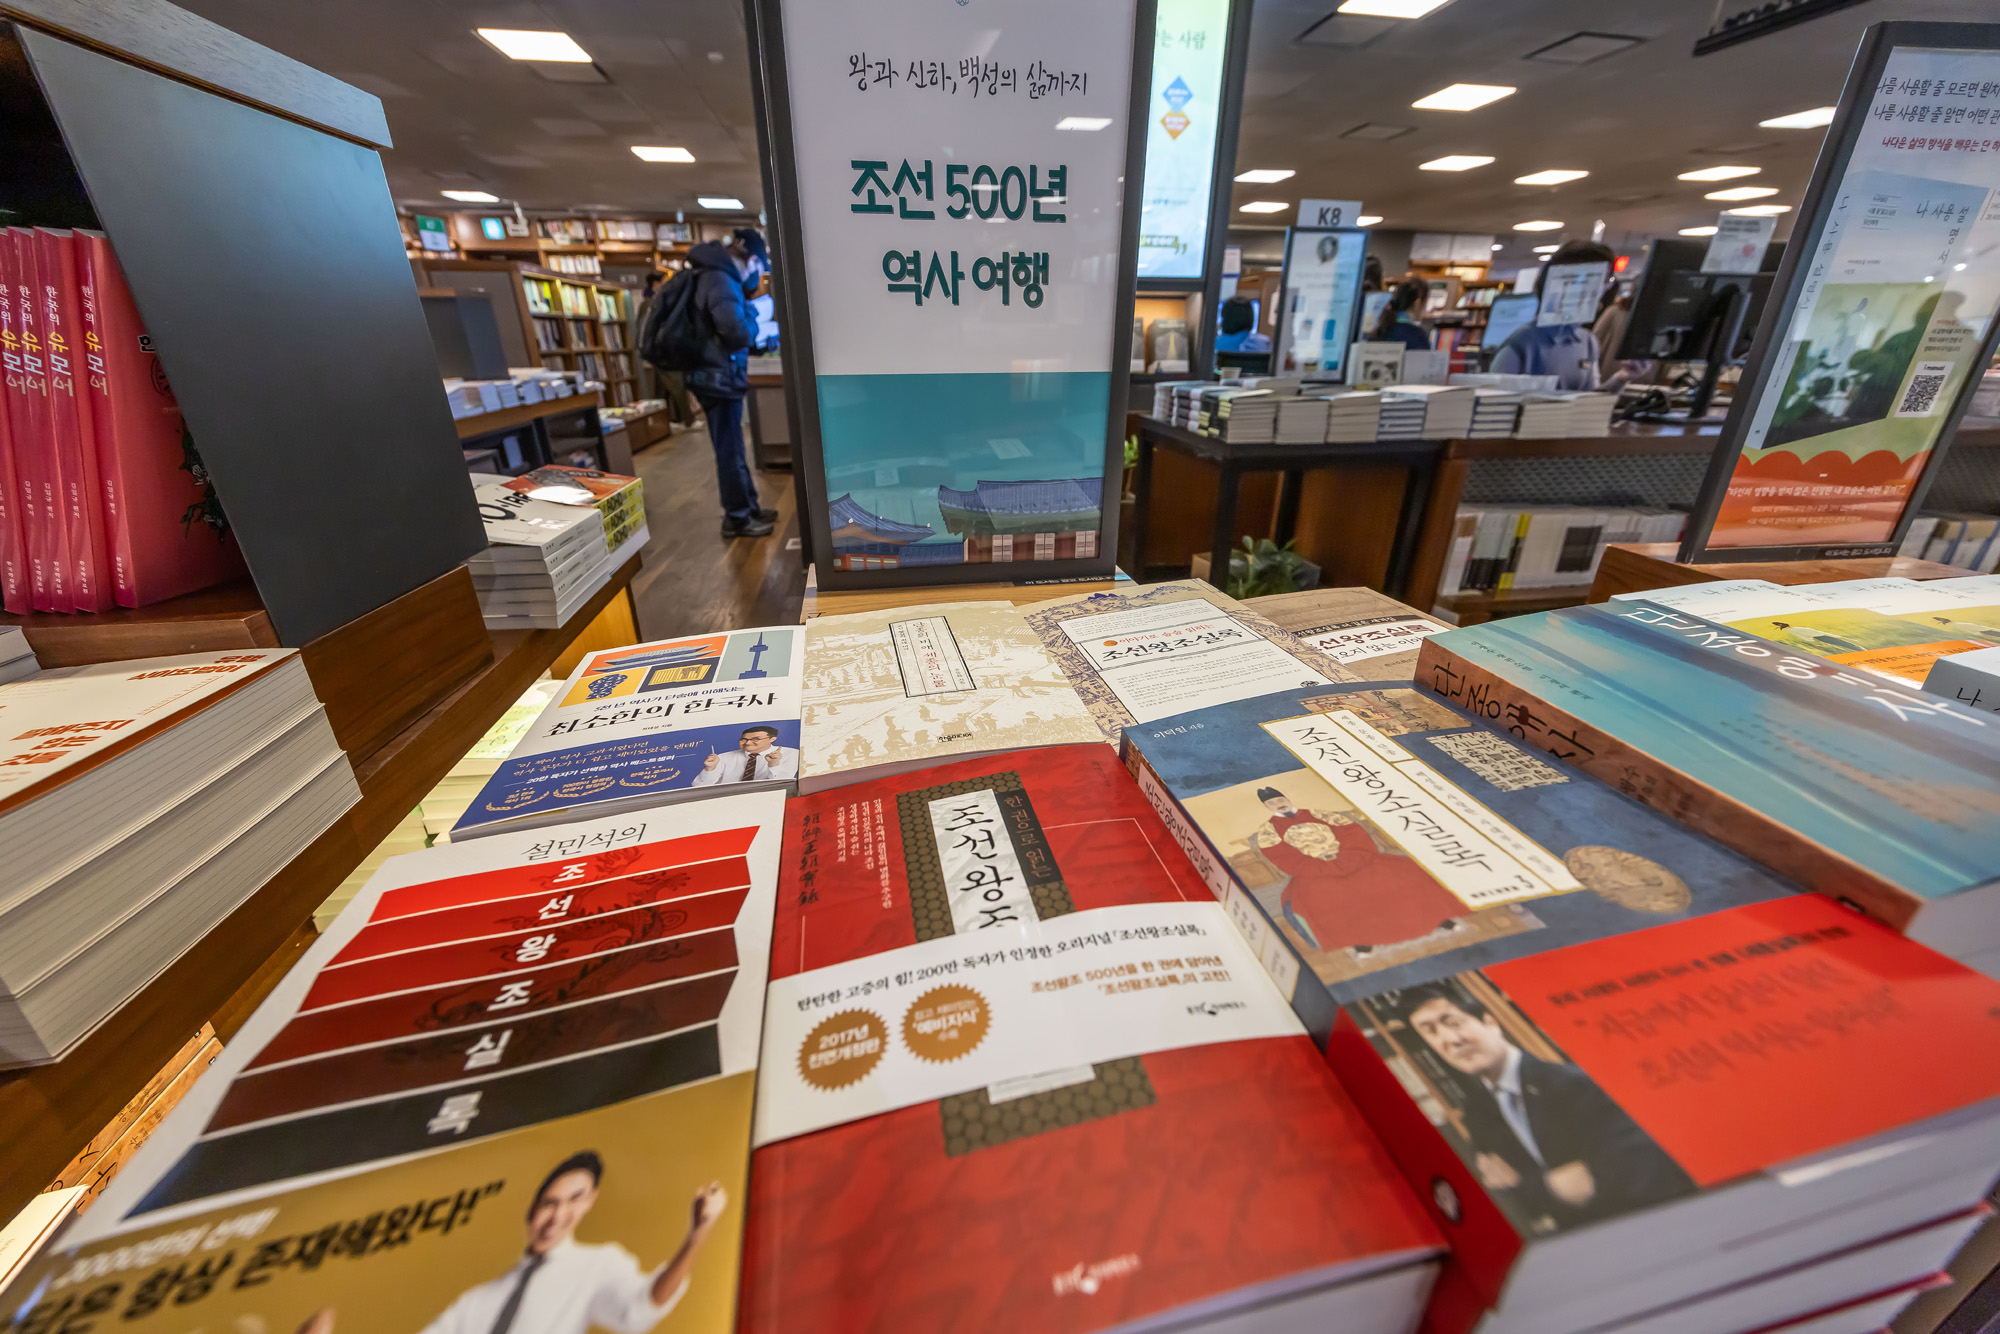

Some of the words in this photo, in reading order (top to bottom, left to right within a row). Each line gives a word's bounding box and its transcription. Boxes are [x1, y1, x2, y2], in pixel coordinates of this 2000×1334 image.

[848, 52, 899, 91] 왕과
[1026, 60, 1088, 99] 삶까지
[1897, 78, 1932, 96] 사용할
[1933, 80, 1946, 95] 줄
[1946, 81, 1980, 98] 모르면
[1874, 104, 1896, 120] 나를
[1897, 104, 1932, 122] 사용할
[1932, 106, 1944, 123] 줄
[850, 158, 936, 221] 조선
[945, 163, 1068, 224] 500년
[1318, 206, 1341, 226] K8
[881, 249, 966, 307] 역사
[971, 250, 1049, 309] 여행
[1102, 628, 1243, 662] 조선왕조실록
[541, 703, 675, 738] 최소한의
[683, 692, 778, 715] 한국사
[630, 695, 662, 706] 역사가
[561, 751, 582, 762] 역사
[580, 764, 608, 776] 선택한
[610, 760, 629, 770] 역사
[630, 753, 675, 767] 베스트셀러
[1293, 725, 1494, 873] 조선왕조실록
[520, 822, 648, 862] 설민석의
[797, 987, 842, 1012] 탄탄한
[844, 975, 889, 1000] 고증의
[894, 969, 915, 992] 힘!
[916, 959, 958, 982] 200만
[963, 948, 1007, 970] 독자가
[1010, 940, 1053, 963] 인정한
[1055, 930, 1113, 955] 오리지널
[1032, 973, 1083, 994] 조선왕조
[818, 1024, 870, 1050] 2017년
